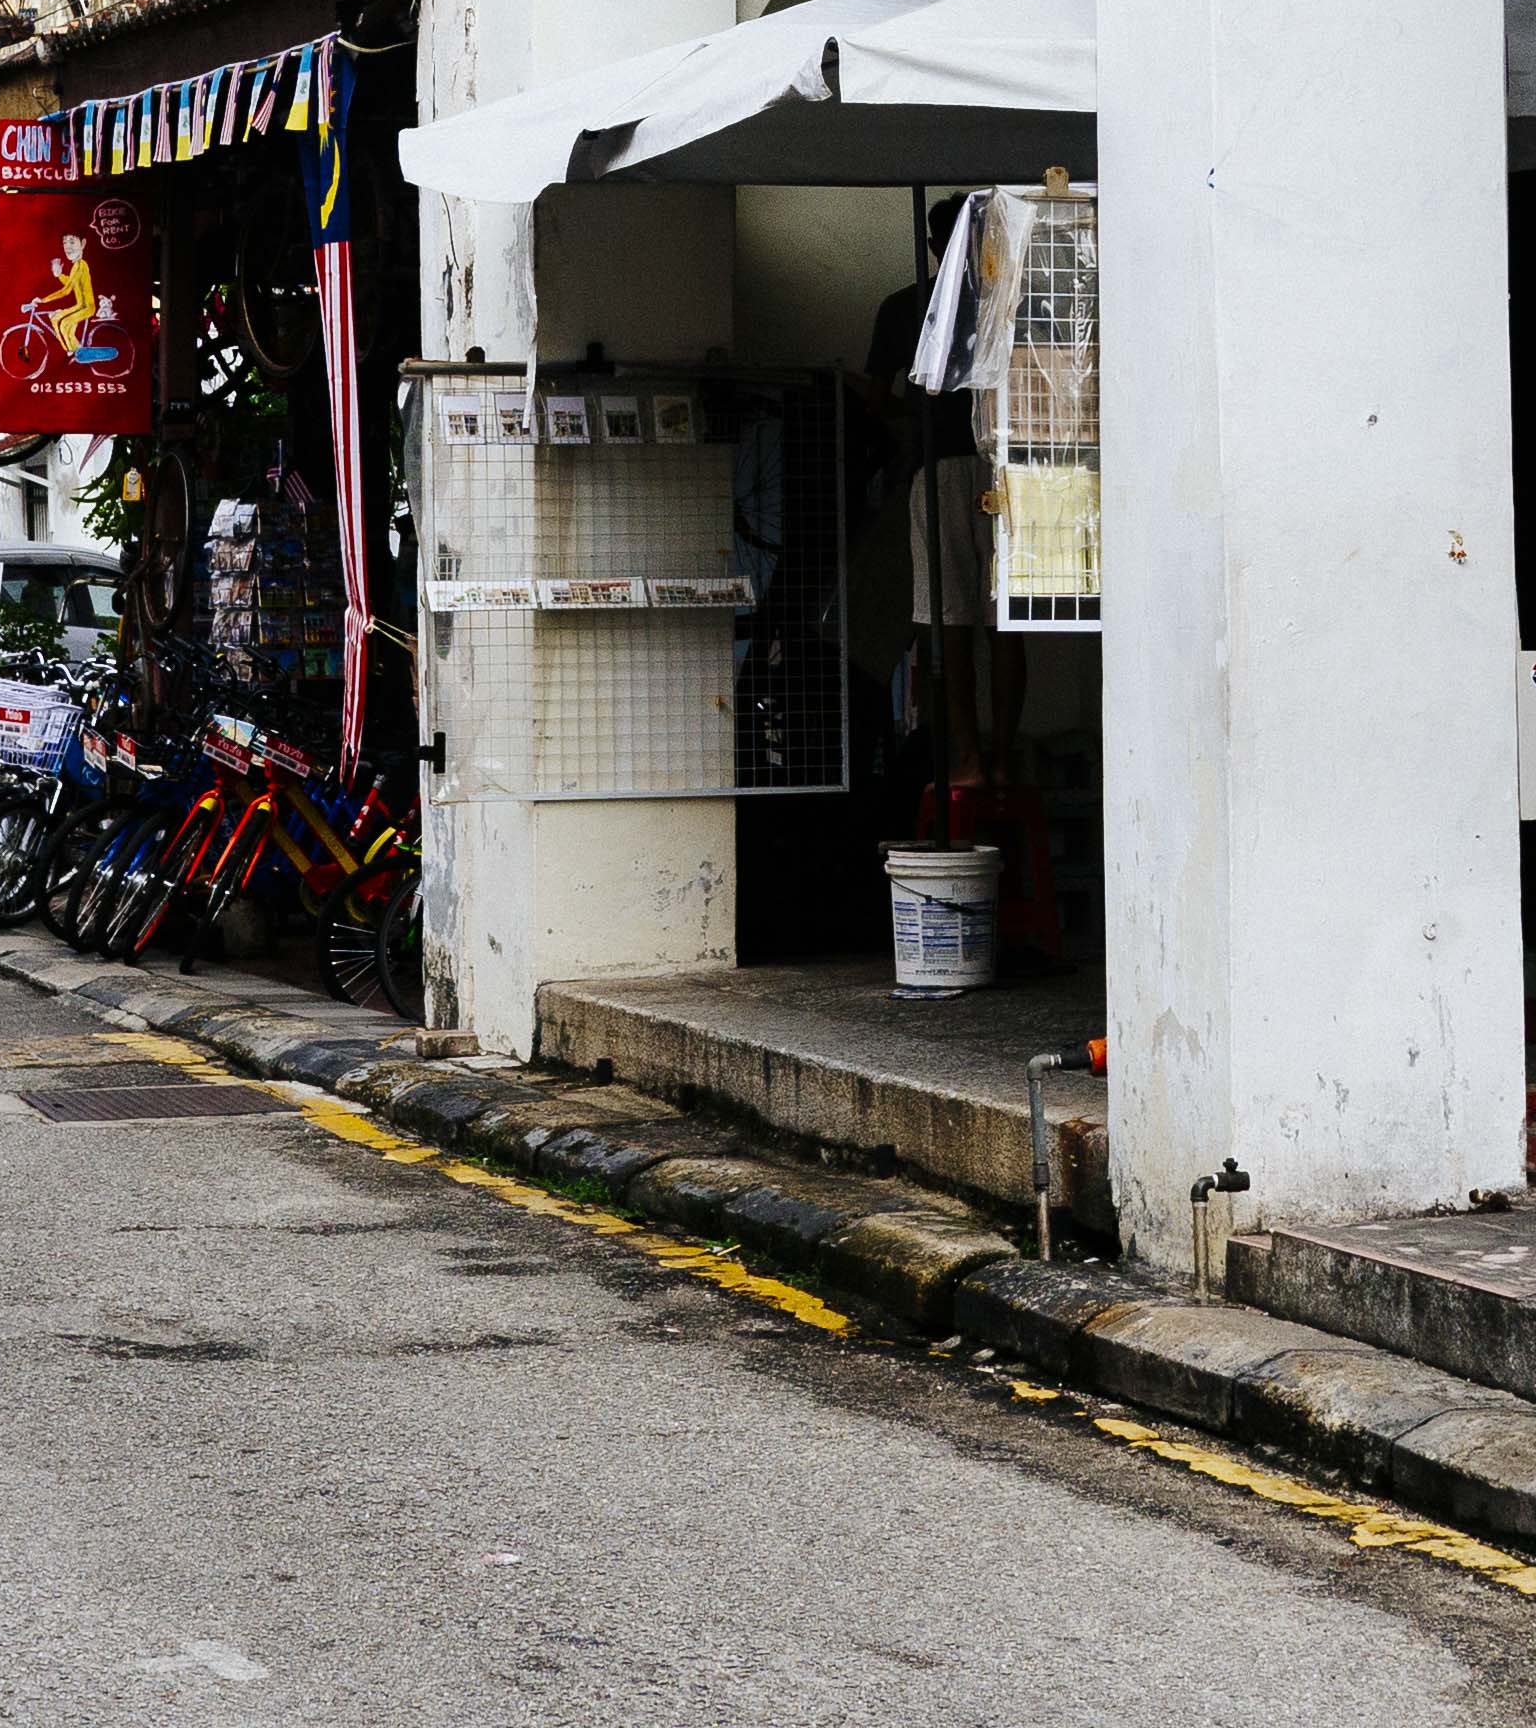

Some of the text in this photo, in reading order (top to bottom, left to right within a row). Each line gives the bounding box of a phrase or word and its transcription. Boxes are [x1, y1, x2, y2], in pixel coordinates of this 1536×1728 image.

[1, 125, 52, 162] CHIN
[98, 208, 126, 217] BIKE
[102, 225, 129, 234] RENT
[30, 382, 128, 393] 012 5533 553
